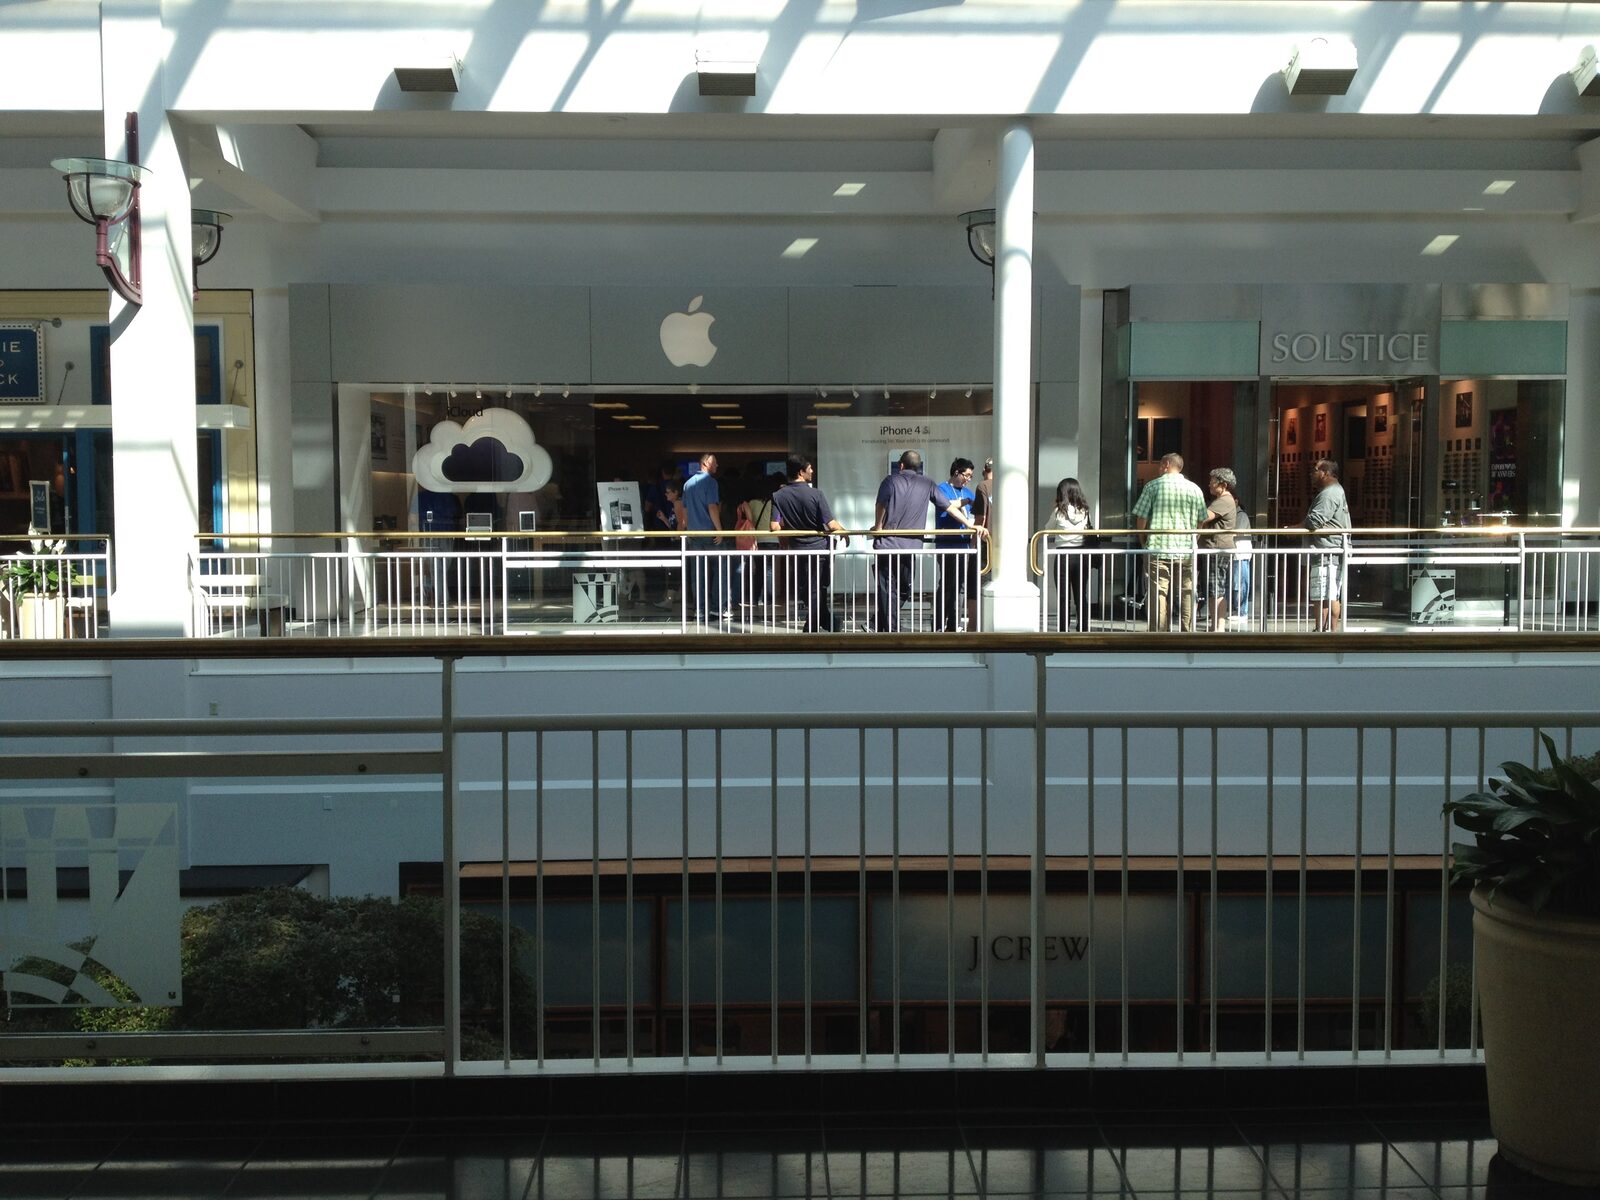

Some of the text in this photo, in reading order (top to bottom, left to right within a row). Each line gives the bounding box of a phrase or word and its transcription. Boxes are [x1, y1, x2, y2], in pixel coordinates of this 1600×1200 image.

[1272, 333, 1429, 363] SOLSTICE
[447, 406, 484, 418] iCloud
[880, 425, 913, 436] iPhone
[991, 935, 1090, 961] CREW
